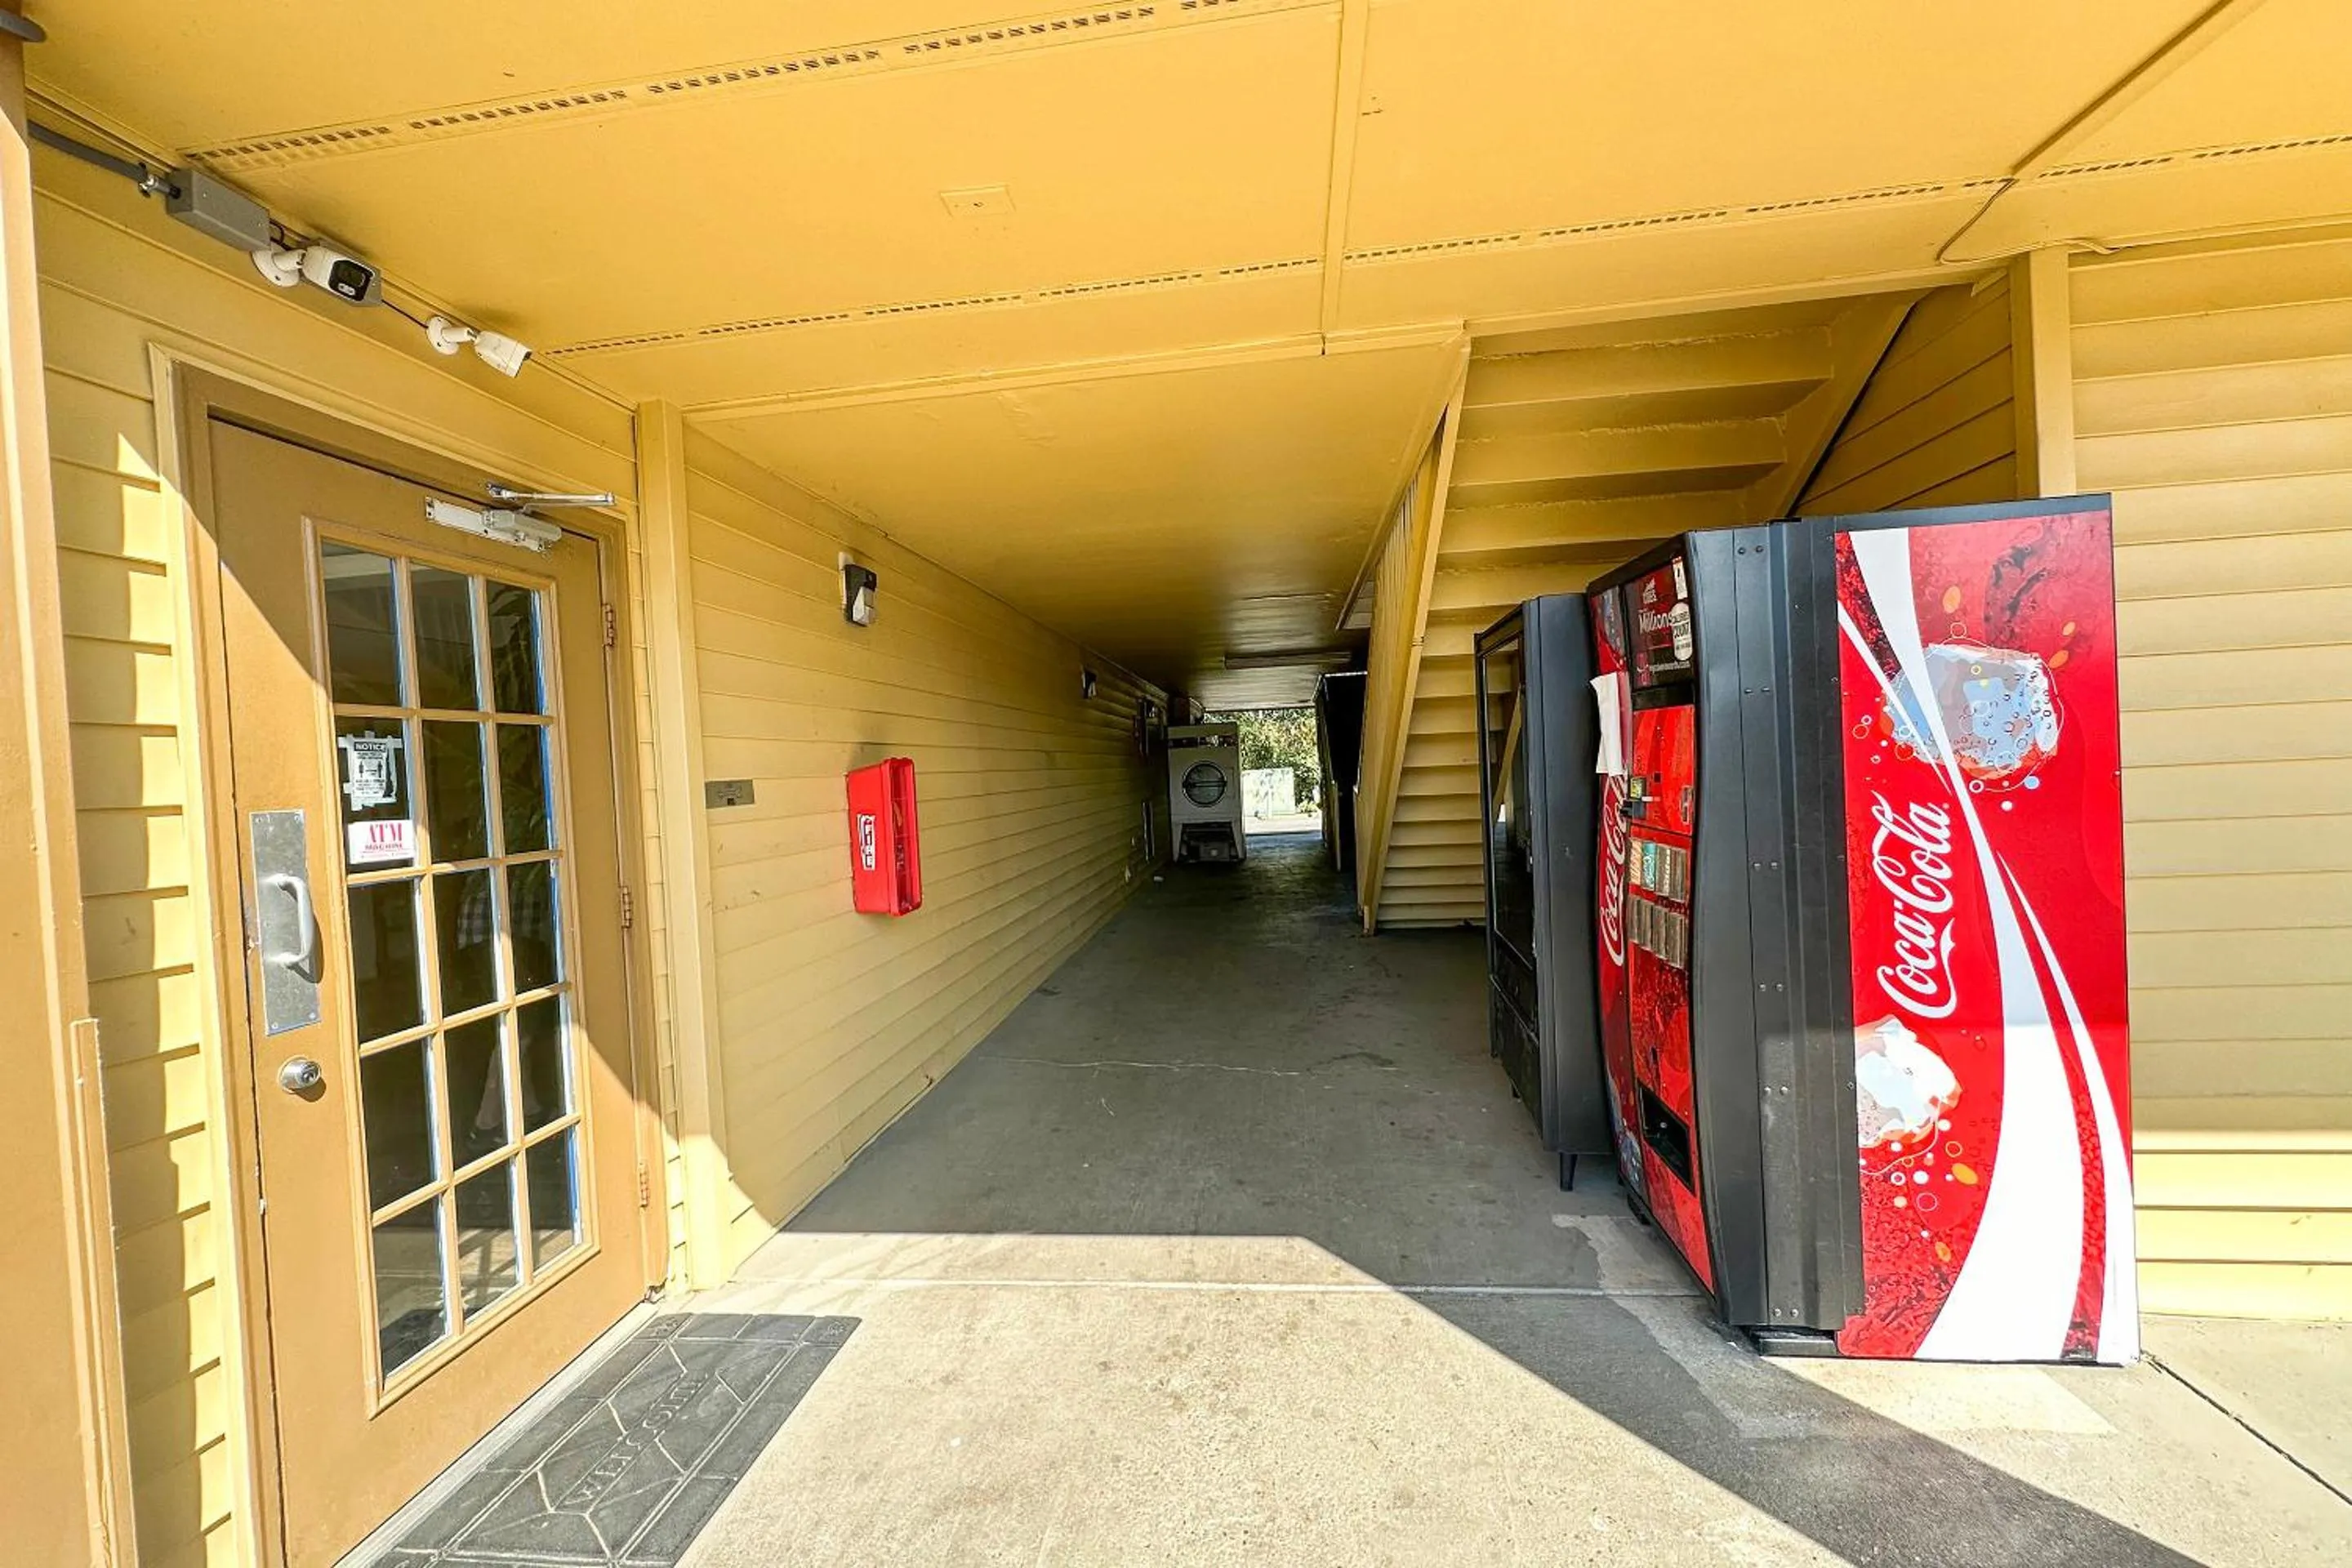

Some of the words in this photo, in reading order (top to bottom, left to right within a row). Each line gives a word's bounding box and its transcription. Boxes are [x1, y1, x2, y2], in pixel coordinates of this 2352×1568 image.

[355, 742, 385, 751] NOTICE
[370, 823, 402, 842] ATM
[1871, 790, 1958, 1018] Coca-Cola
